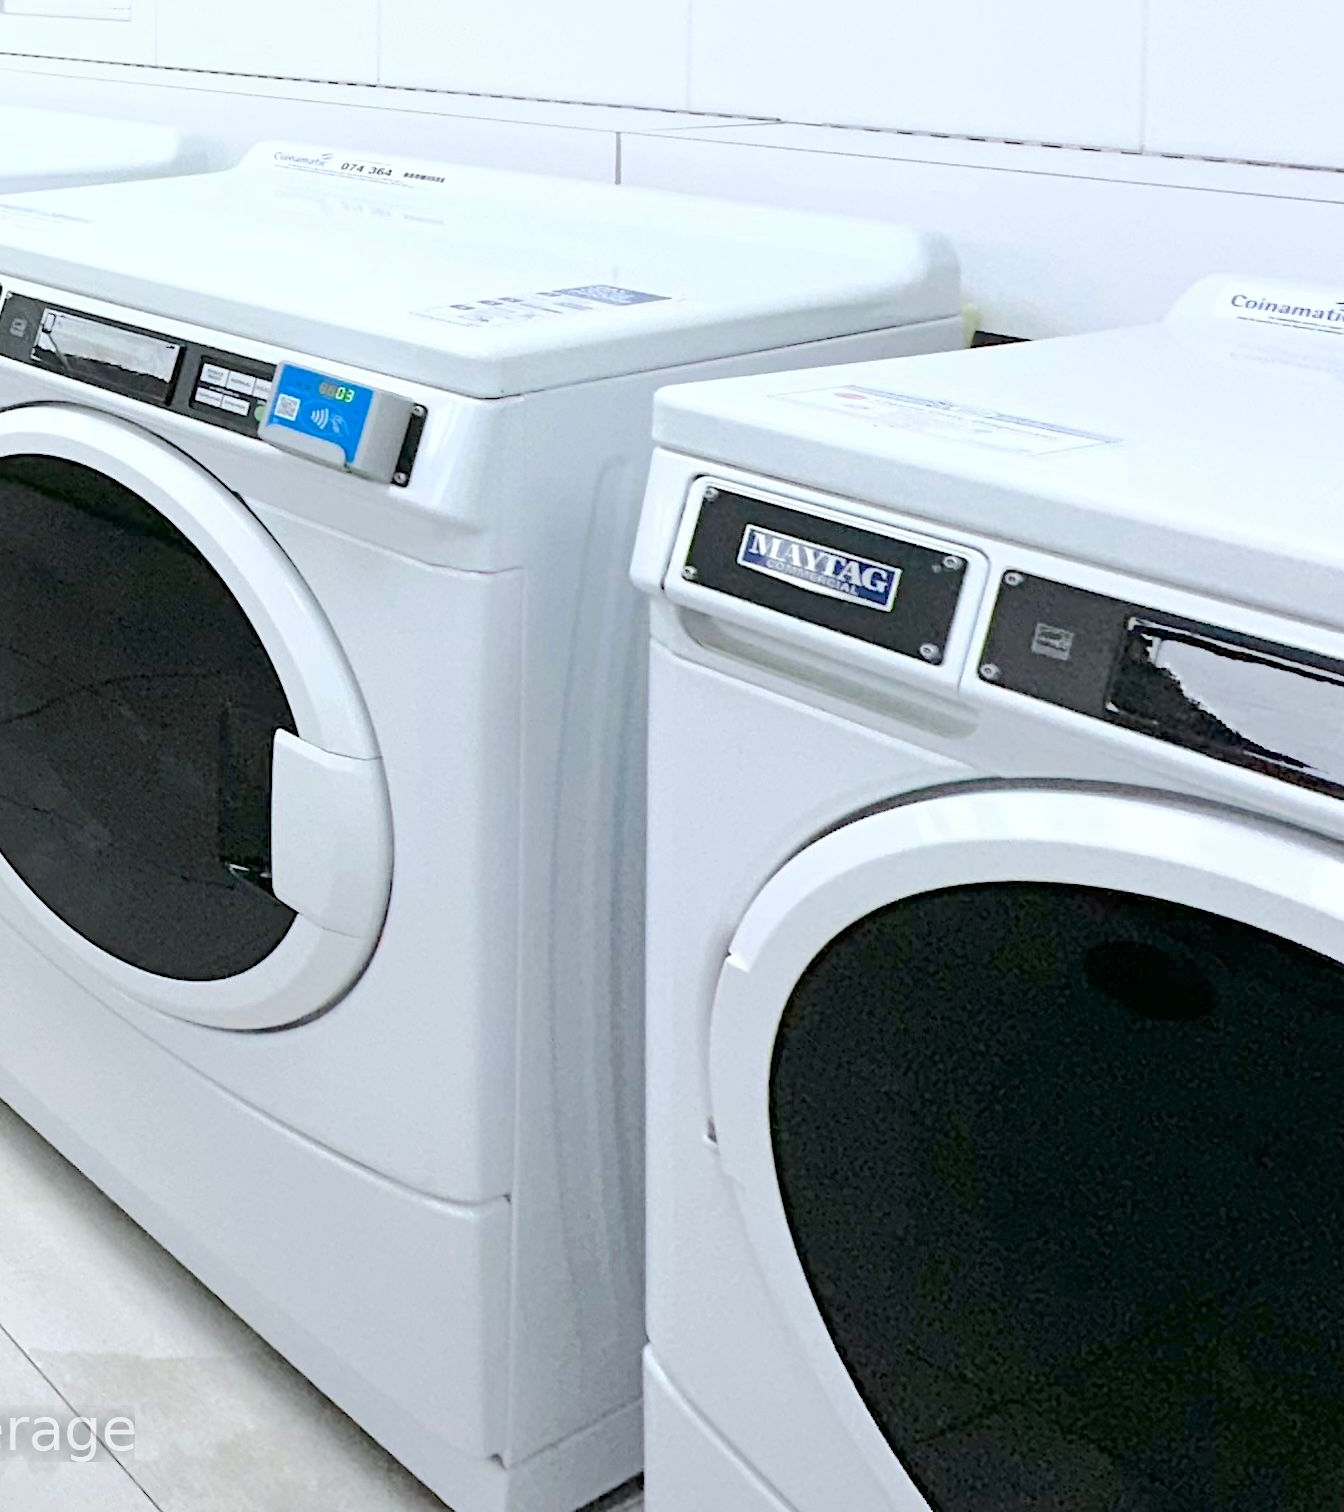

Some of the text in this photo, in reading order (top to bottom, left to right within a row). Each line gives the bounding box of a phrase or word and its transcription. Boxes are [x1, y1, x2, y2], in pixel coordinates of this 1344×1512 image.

[340, 162, 365, 173] 074
[368, 166, 393, 177] 364
[1231, 294, 1344, 322] Coinamati
[747, 531, 889, 594] MAYTAG
[766, 558, 859, 598] COMMERCIAL
